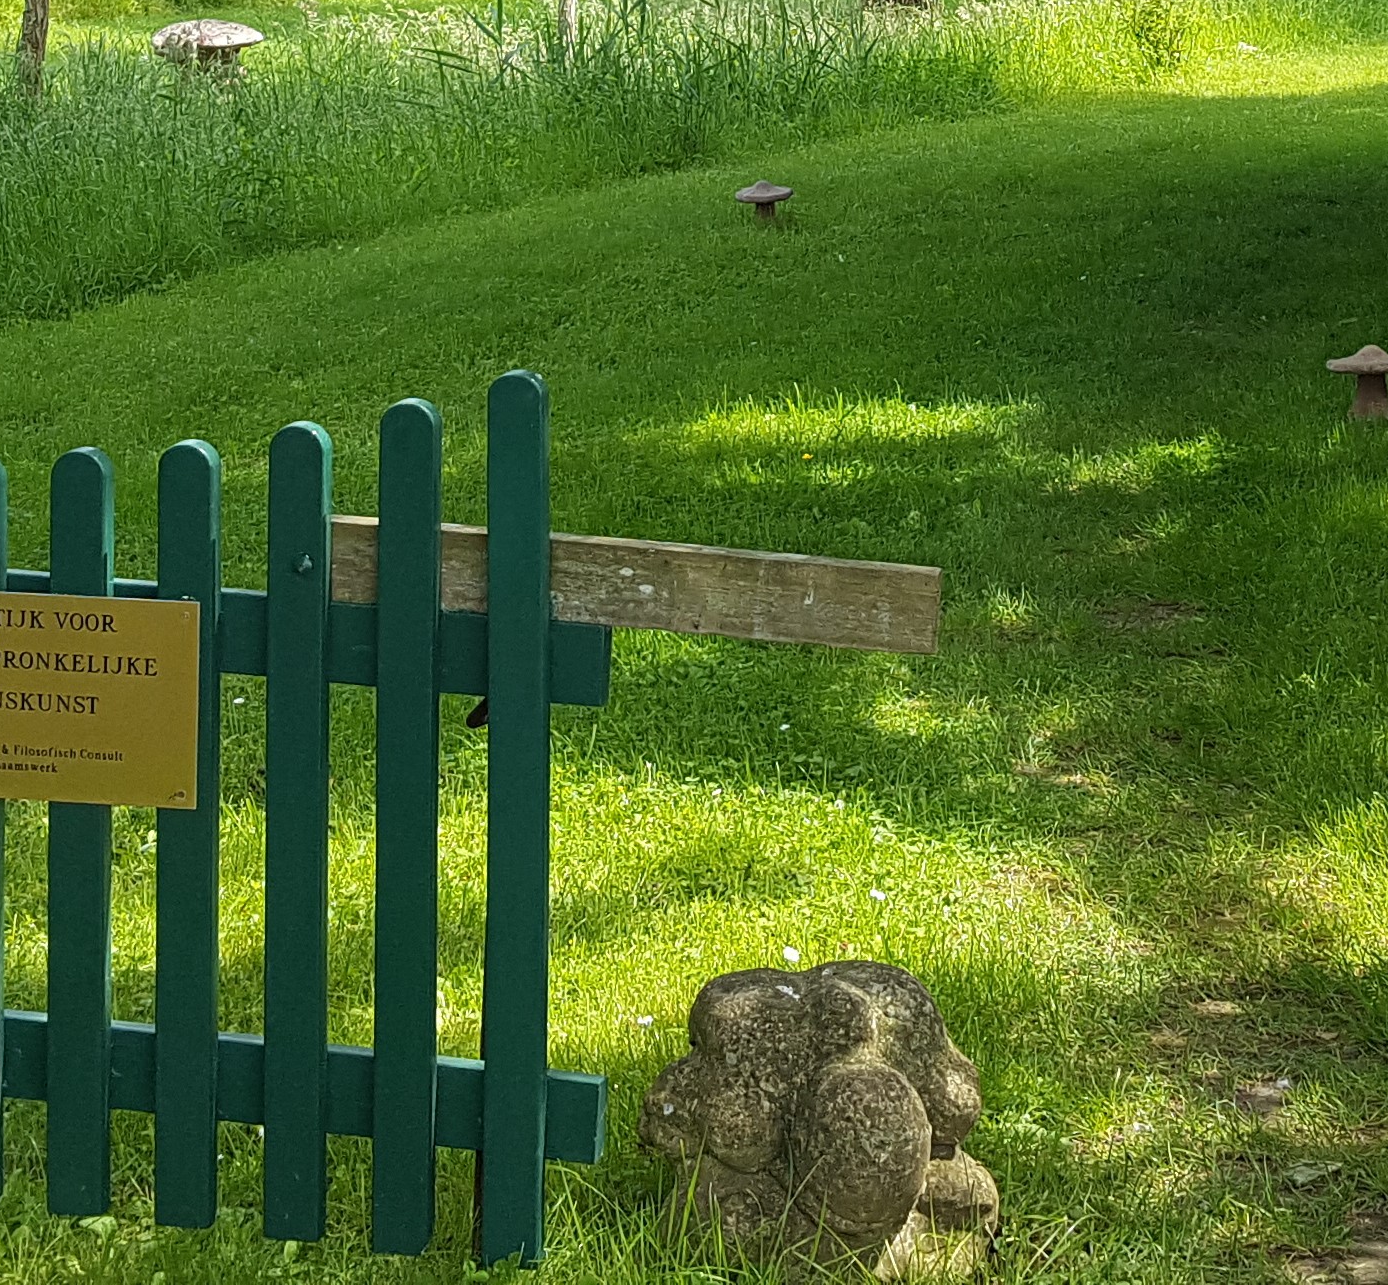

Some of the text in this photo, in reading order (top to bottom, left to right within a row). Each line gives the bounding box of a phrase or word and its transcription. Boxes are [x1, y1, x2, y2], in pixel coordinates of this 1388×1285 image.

[2, 745, 9, 755] &
[14, 745, 76, 760] Filosofisch
[80, 749, 124, 761] Consult
